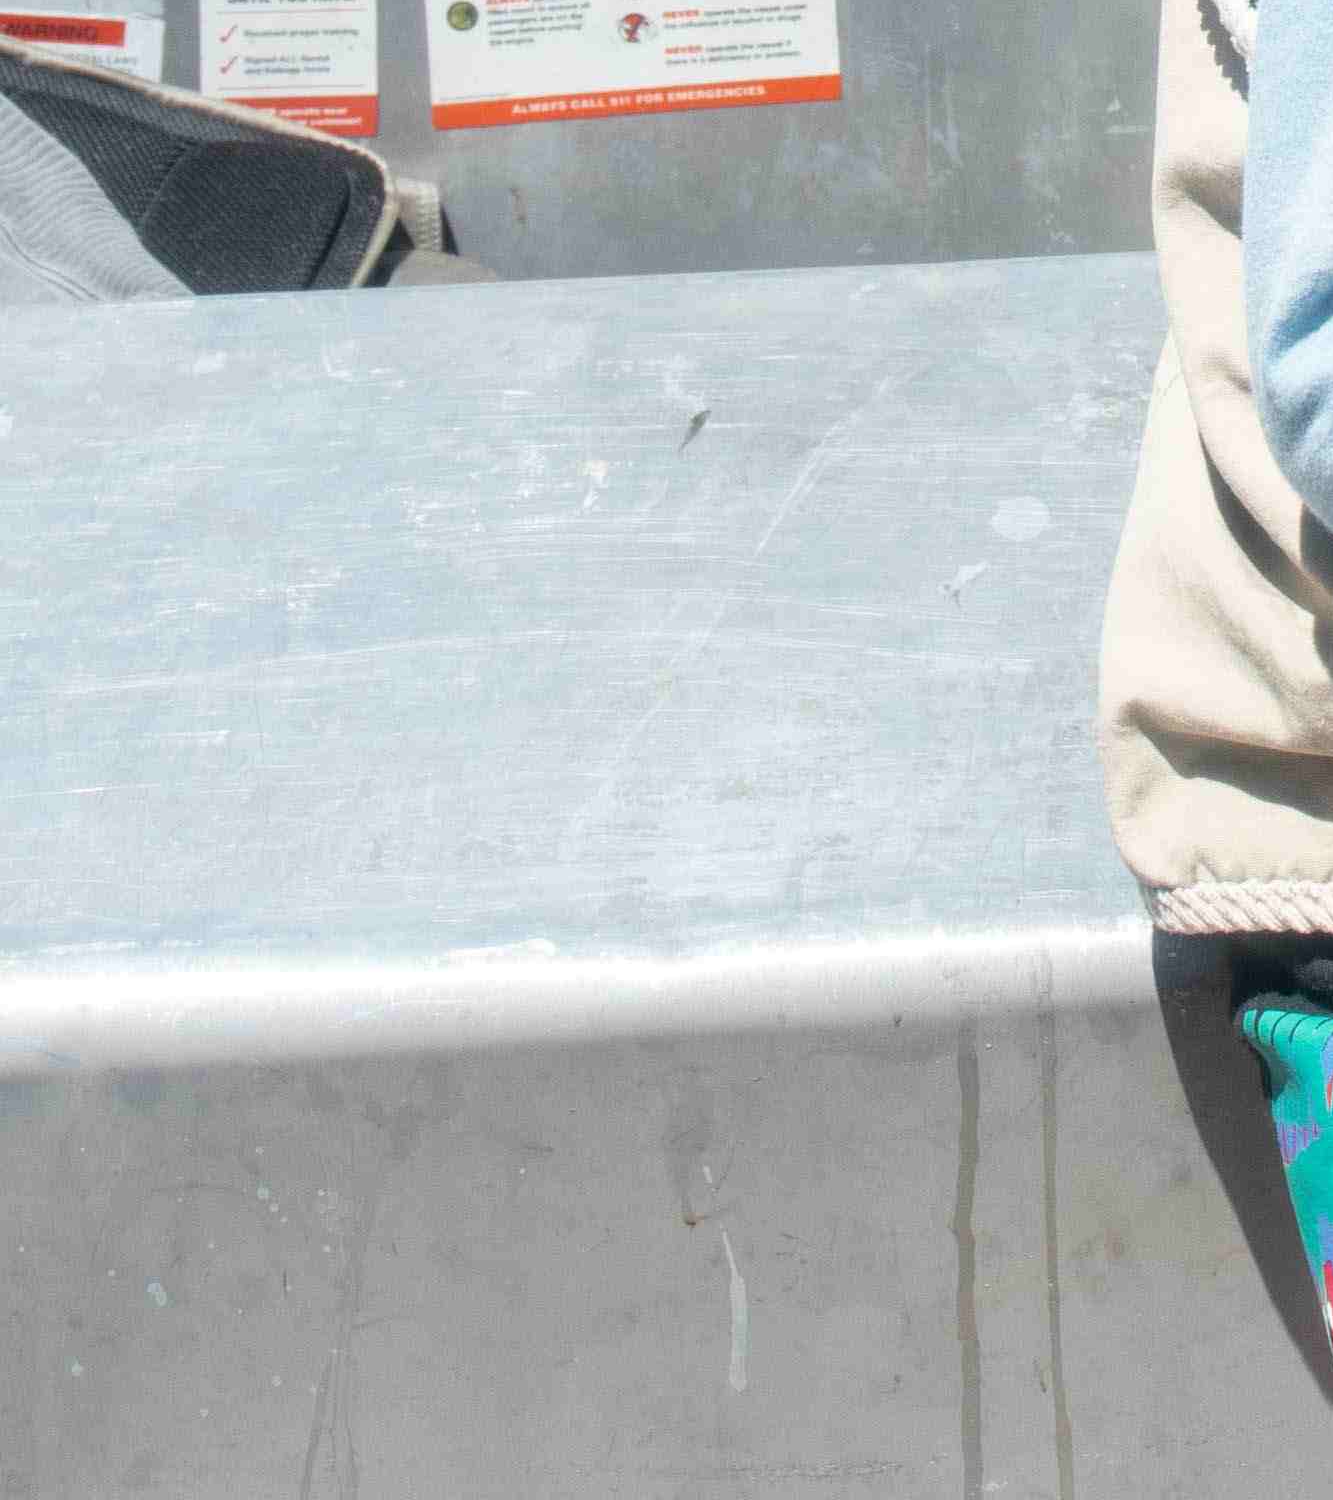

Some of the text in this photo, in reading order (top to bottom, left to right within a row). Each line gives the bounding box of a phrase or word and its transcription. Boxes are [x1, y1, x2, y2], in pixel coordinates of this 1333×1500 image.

[512, 101, 567, 115] ALWAYS
[570, 98, 604, 109] CALL
[636, 93, 664, 104] FOR
[667, 85, 766, 102] EMERGENCIES
